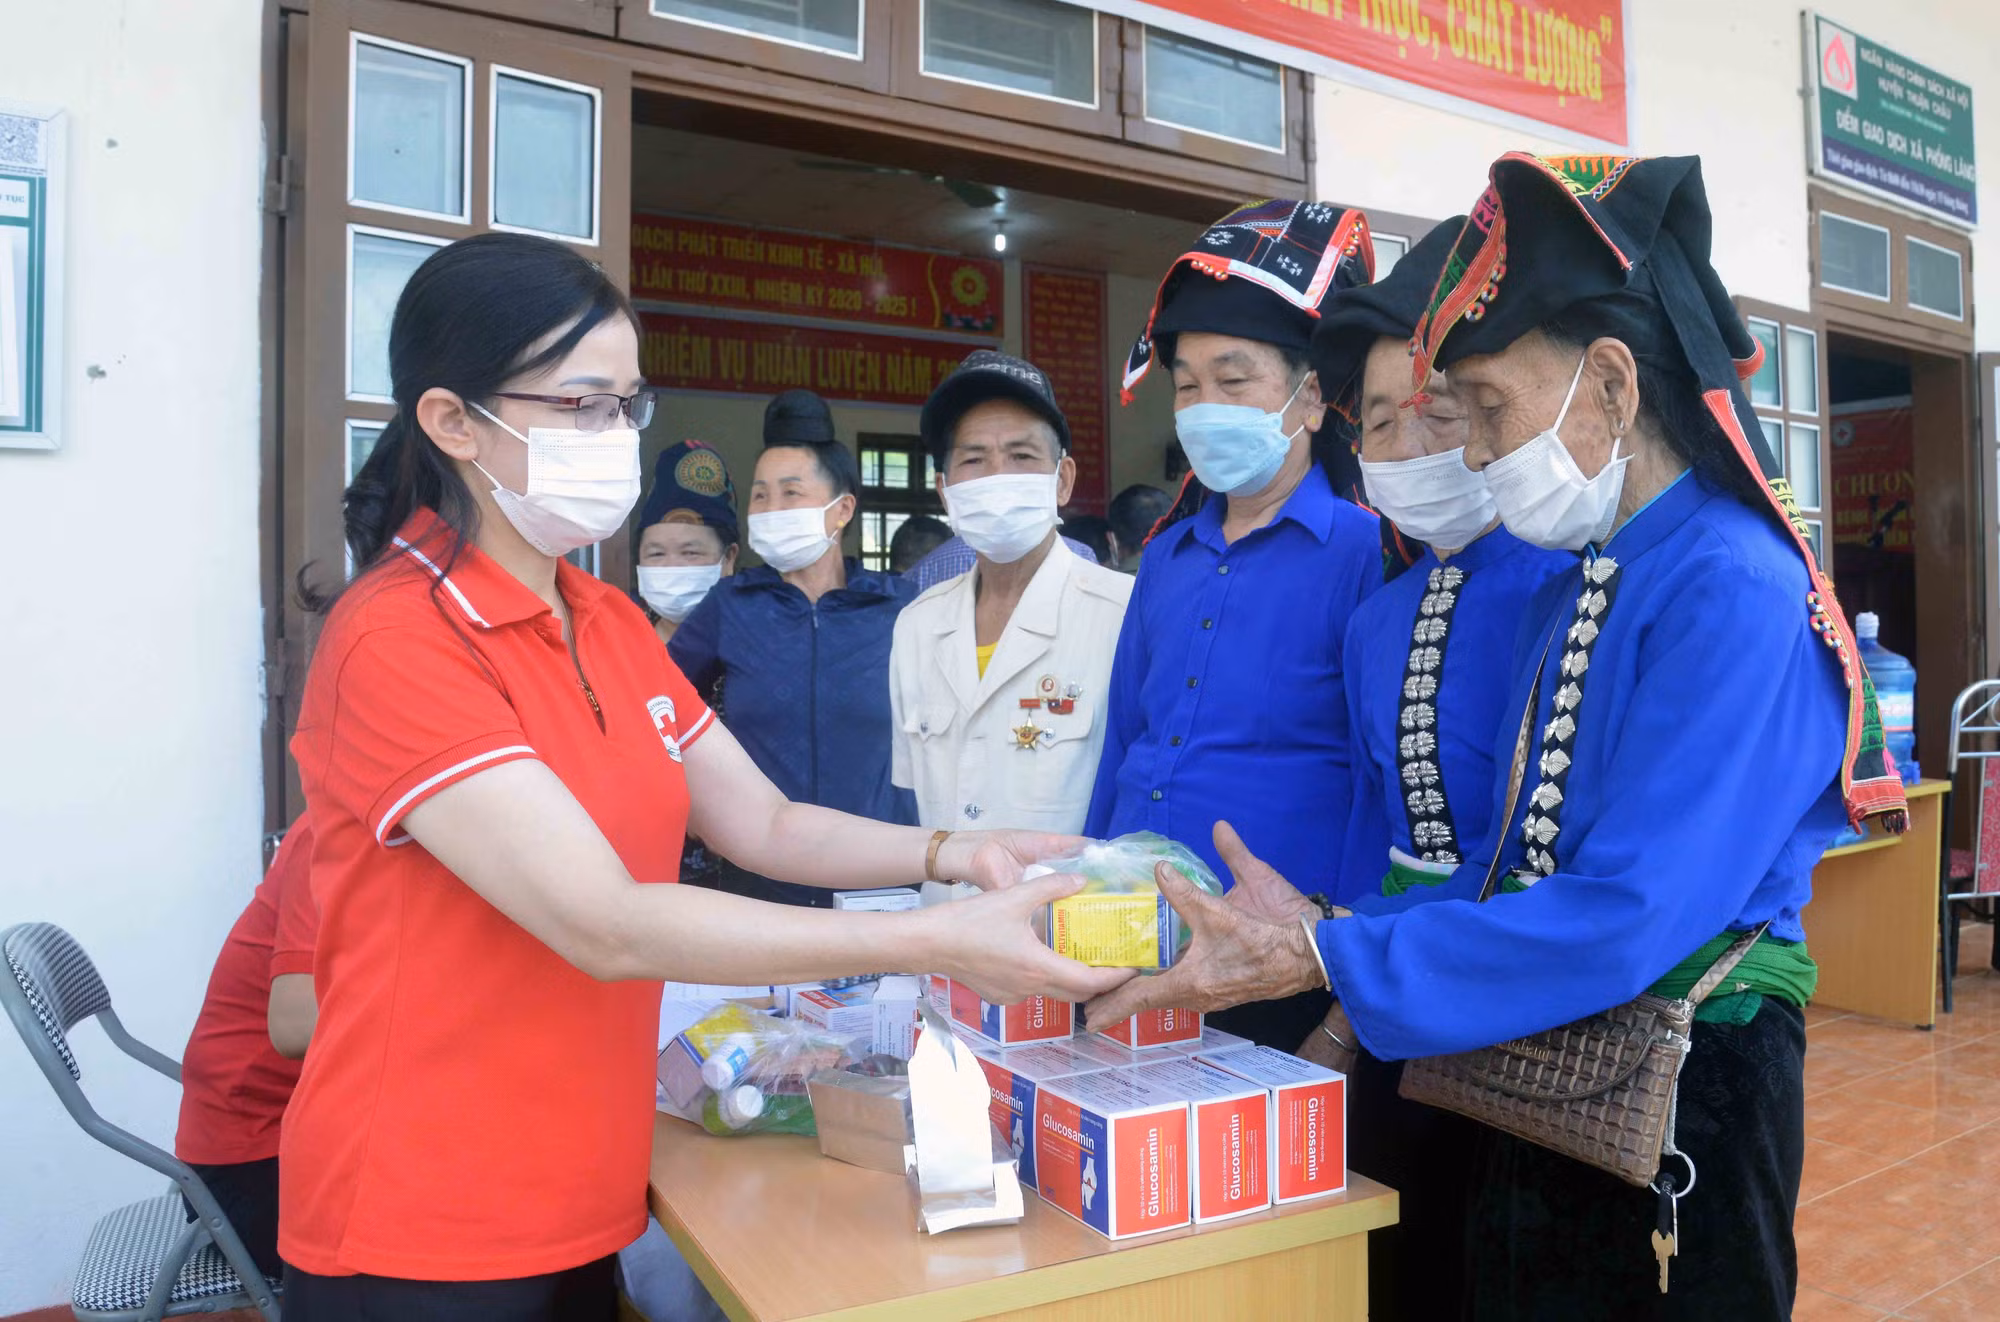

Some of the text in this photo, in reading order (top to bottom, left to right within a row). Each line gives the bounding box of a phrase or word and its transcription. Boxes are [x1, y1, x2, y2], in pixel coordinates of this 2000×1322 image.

[1862, 119, 1885, 146] GIAO
[1886, 130, 1907, 155] DỊCH
[631, 223, 674, 255] OẠCH
[768, 242, 803, 268] KINH
[808, 242, 824, 270] TẾ
[828, 287, 862, 312] 2020
[875, 295, 908, 318] 2025
[719, 338, 746, 390] VỤ
[817, 342, 881, 399] LUYỆN
[887, 348, 932, 396] NĂM
[1256, 1045, 1311, 1069] Glucosamin
[991, 1087, 1024, 1112] cosamin
[1042, 1113, 1095, 1150] Glucosamin
[1308, 1097, 1319, 1181] Glucosamin
[1147, 1127, 1159, 1217] Glucosamin
[1229, 1114, 1241, 1200] Glucosamin
